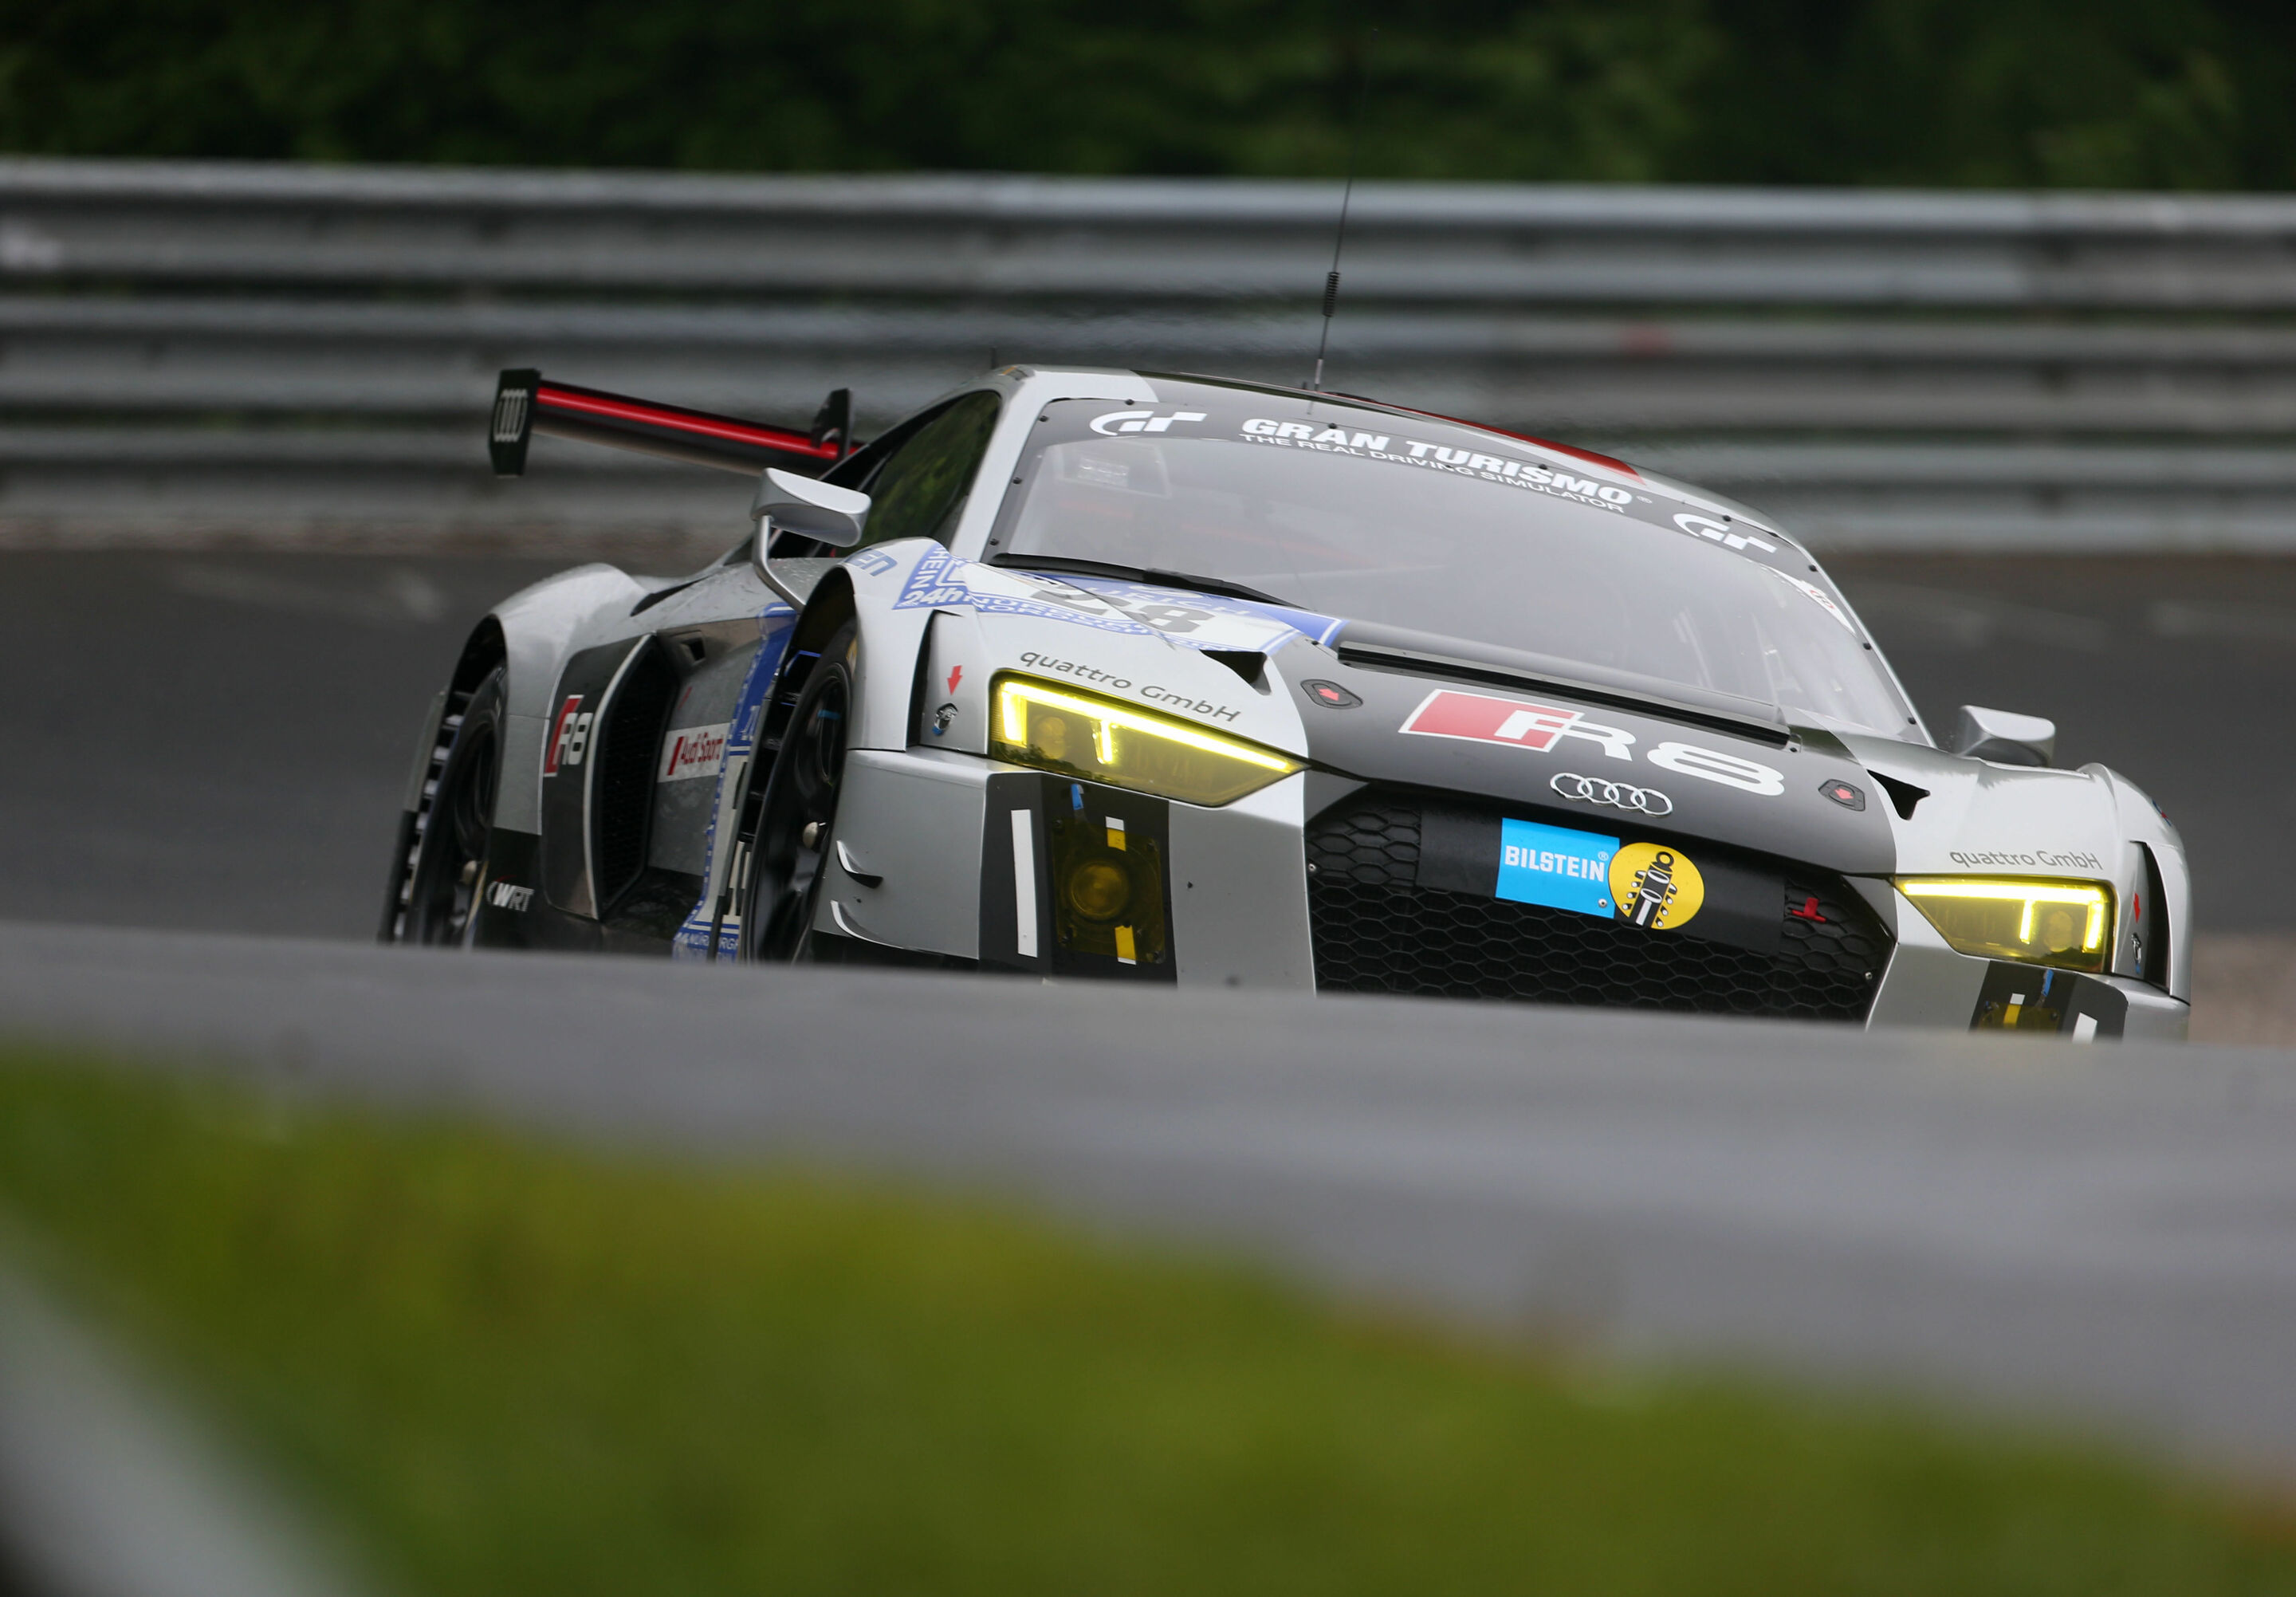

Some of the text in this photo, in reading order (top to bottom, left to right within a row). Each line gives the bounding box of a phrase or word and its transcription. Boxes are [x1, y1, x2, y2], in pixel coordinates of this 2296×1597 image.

[1238, 433, 1626, 514] THE REAL DRIVING SIMULATOR
[1241, 418, 1633, 505] GRAN TURISMO
[1029, 583, 1217, 633] 28
[1020, 651, 1243, 723] quattro GmbH
[1949, 849, 2105, 871] quattro GmbH
